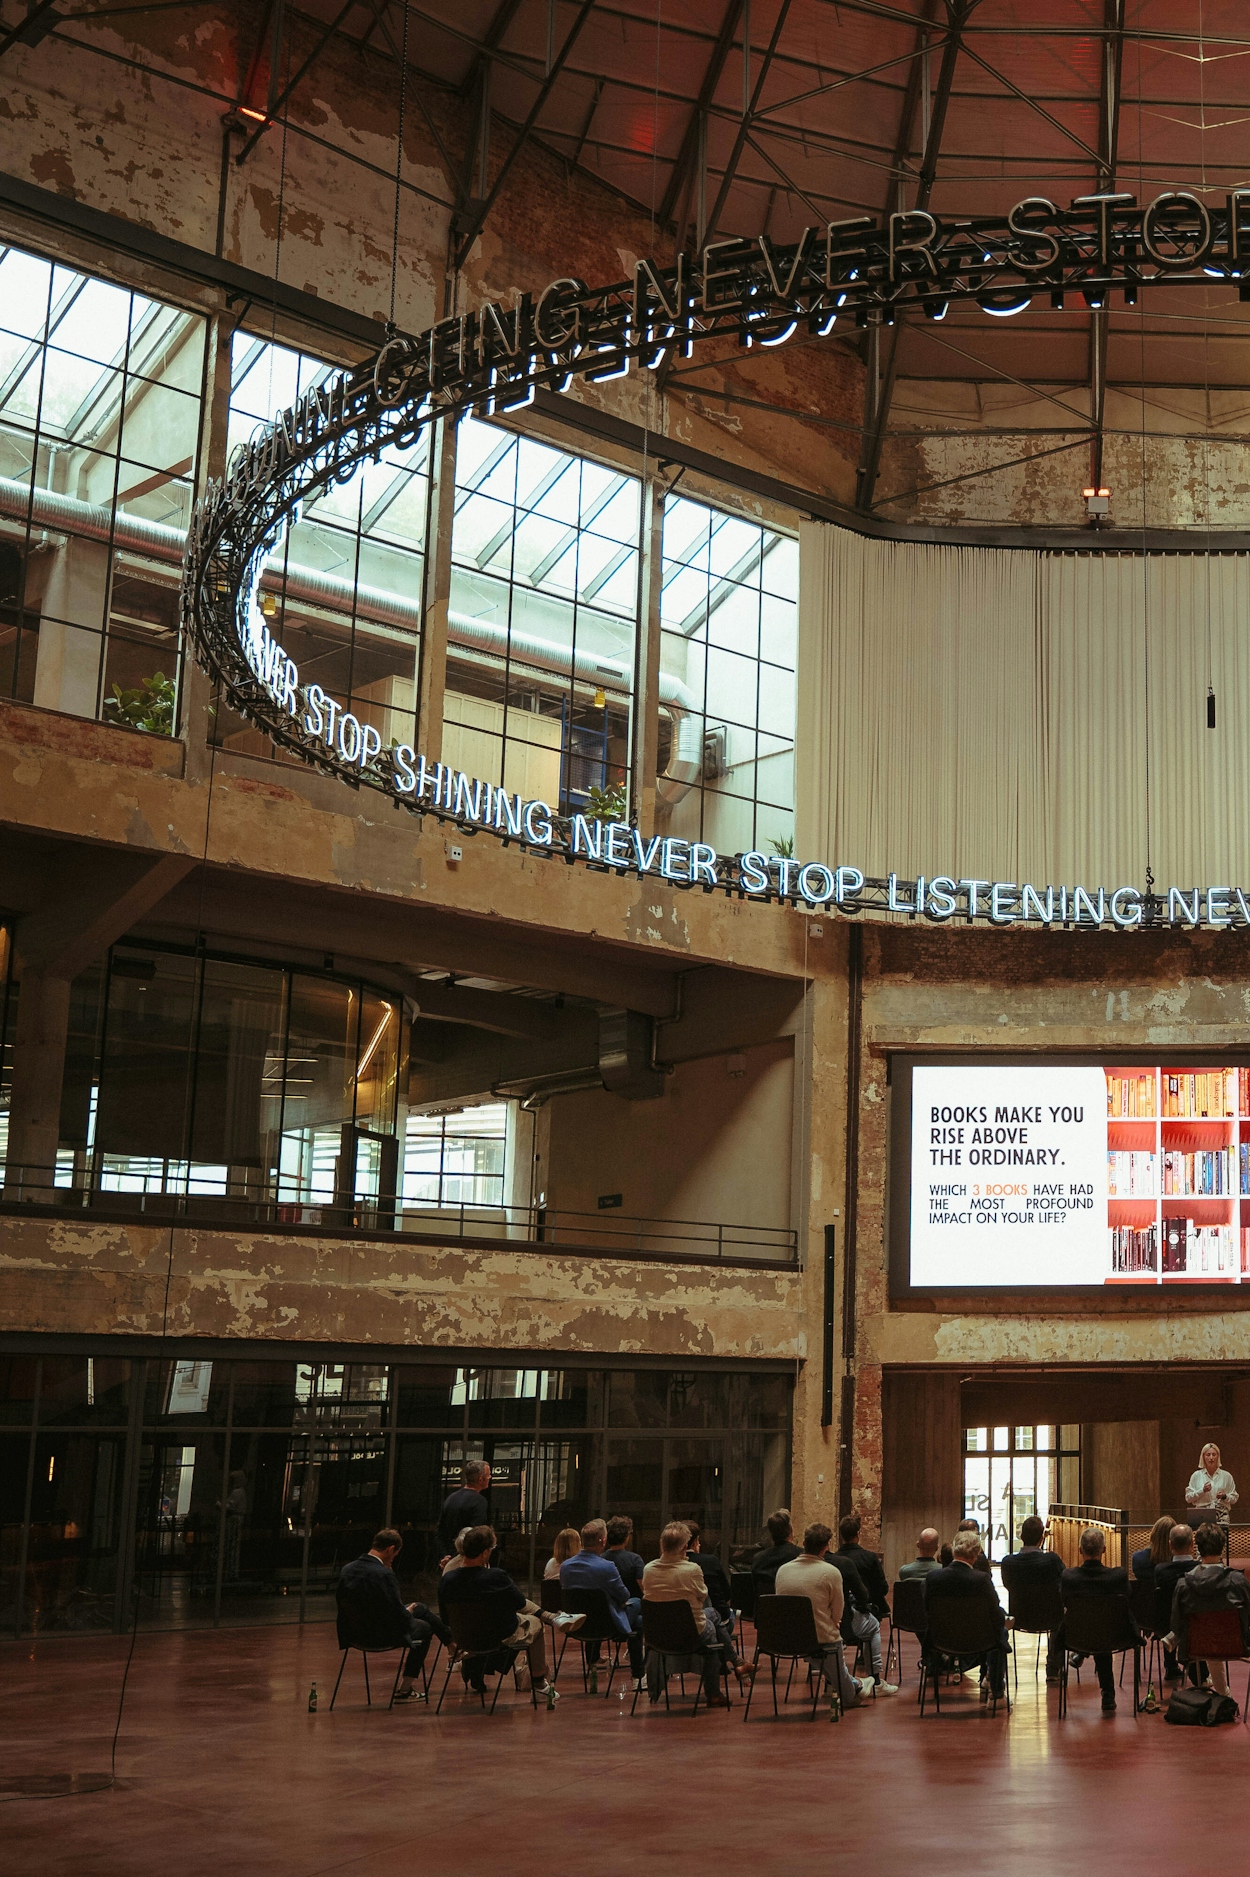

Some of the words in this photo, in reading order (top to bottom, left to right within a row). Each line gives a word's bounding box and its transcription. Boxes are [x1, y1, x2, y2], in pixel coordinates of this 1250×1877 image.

[632, 206, 942, 328] NEVER
[303, 683, 382, 768] STOP
[392, 742, 555, 846] SHINING
[570, 812, 719, 886] NEVER
[739, 850, 866, 904] STOP
[887, 873, 1144, 926] LISTENING
[930, 1106, 987, 1123] BOOKS
[995, 1106, 1041, 1123] MAKE
[1049, 1106, 1084, 1123] YOU
[930, 1128, 965, 1144] RISE
[972, 1128, 1027, 1144] ABOVE
[930, 1149, 961, 1165] THE
[969, 1149, 1065, 1165] ORDINARY.
[930, 1184, 967, 1195] WHICH
[973, 1184, 980, 1195] 3
[986, 1184, 1027, 1195] BOOKS
[1034, 1184, 1063, 1195] HAVE
[1070, 1184, 1093, 1195] HAD
[930, 1198, 949, 1209] THE
[970, 1198, 1005, 1209] MOST
[1026, 1198, 1093, 1209] PROFOUND
[930, 1212, 972, 1223] IMPACT
[976, 1212, 996, 1223] ON
[1001, 1212, 1033, 1223] YOUR
[1039, 1212, 1066, 1223] LIFE?
